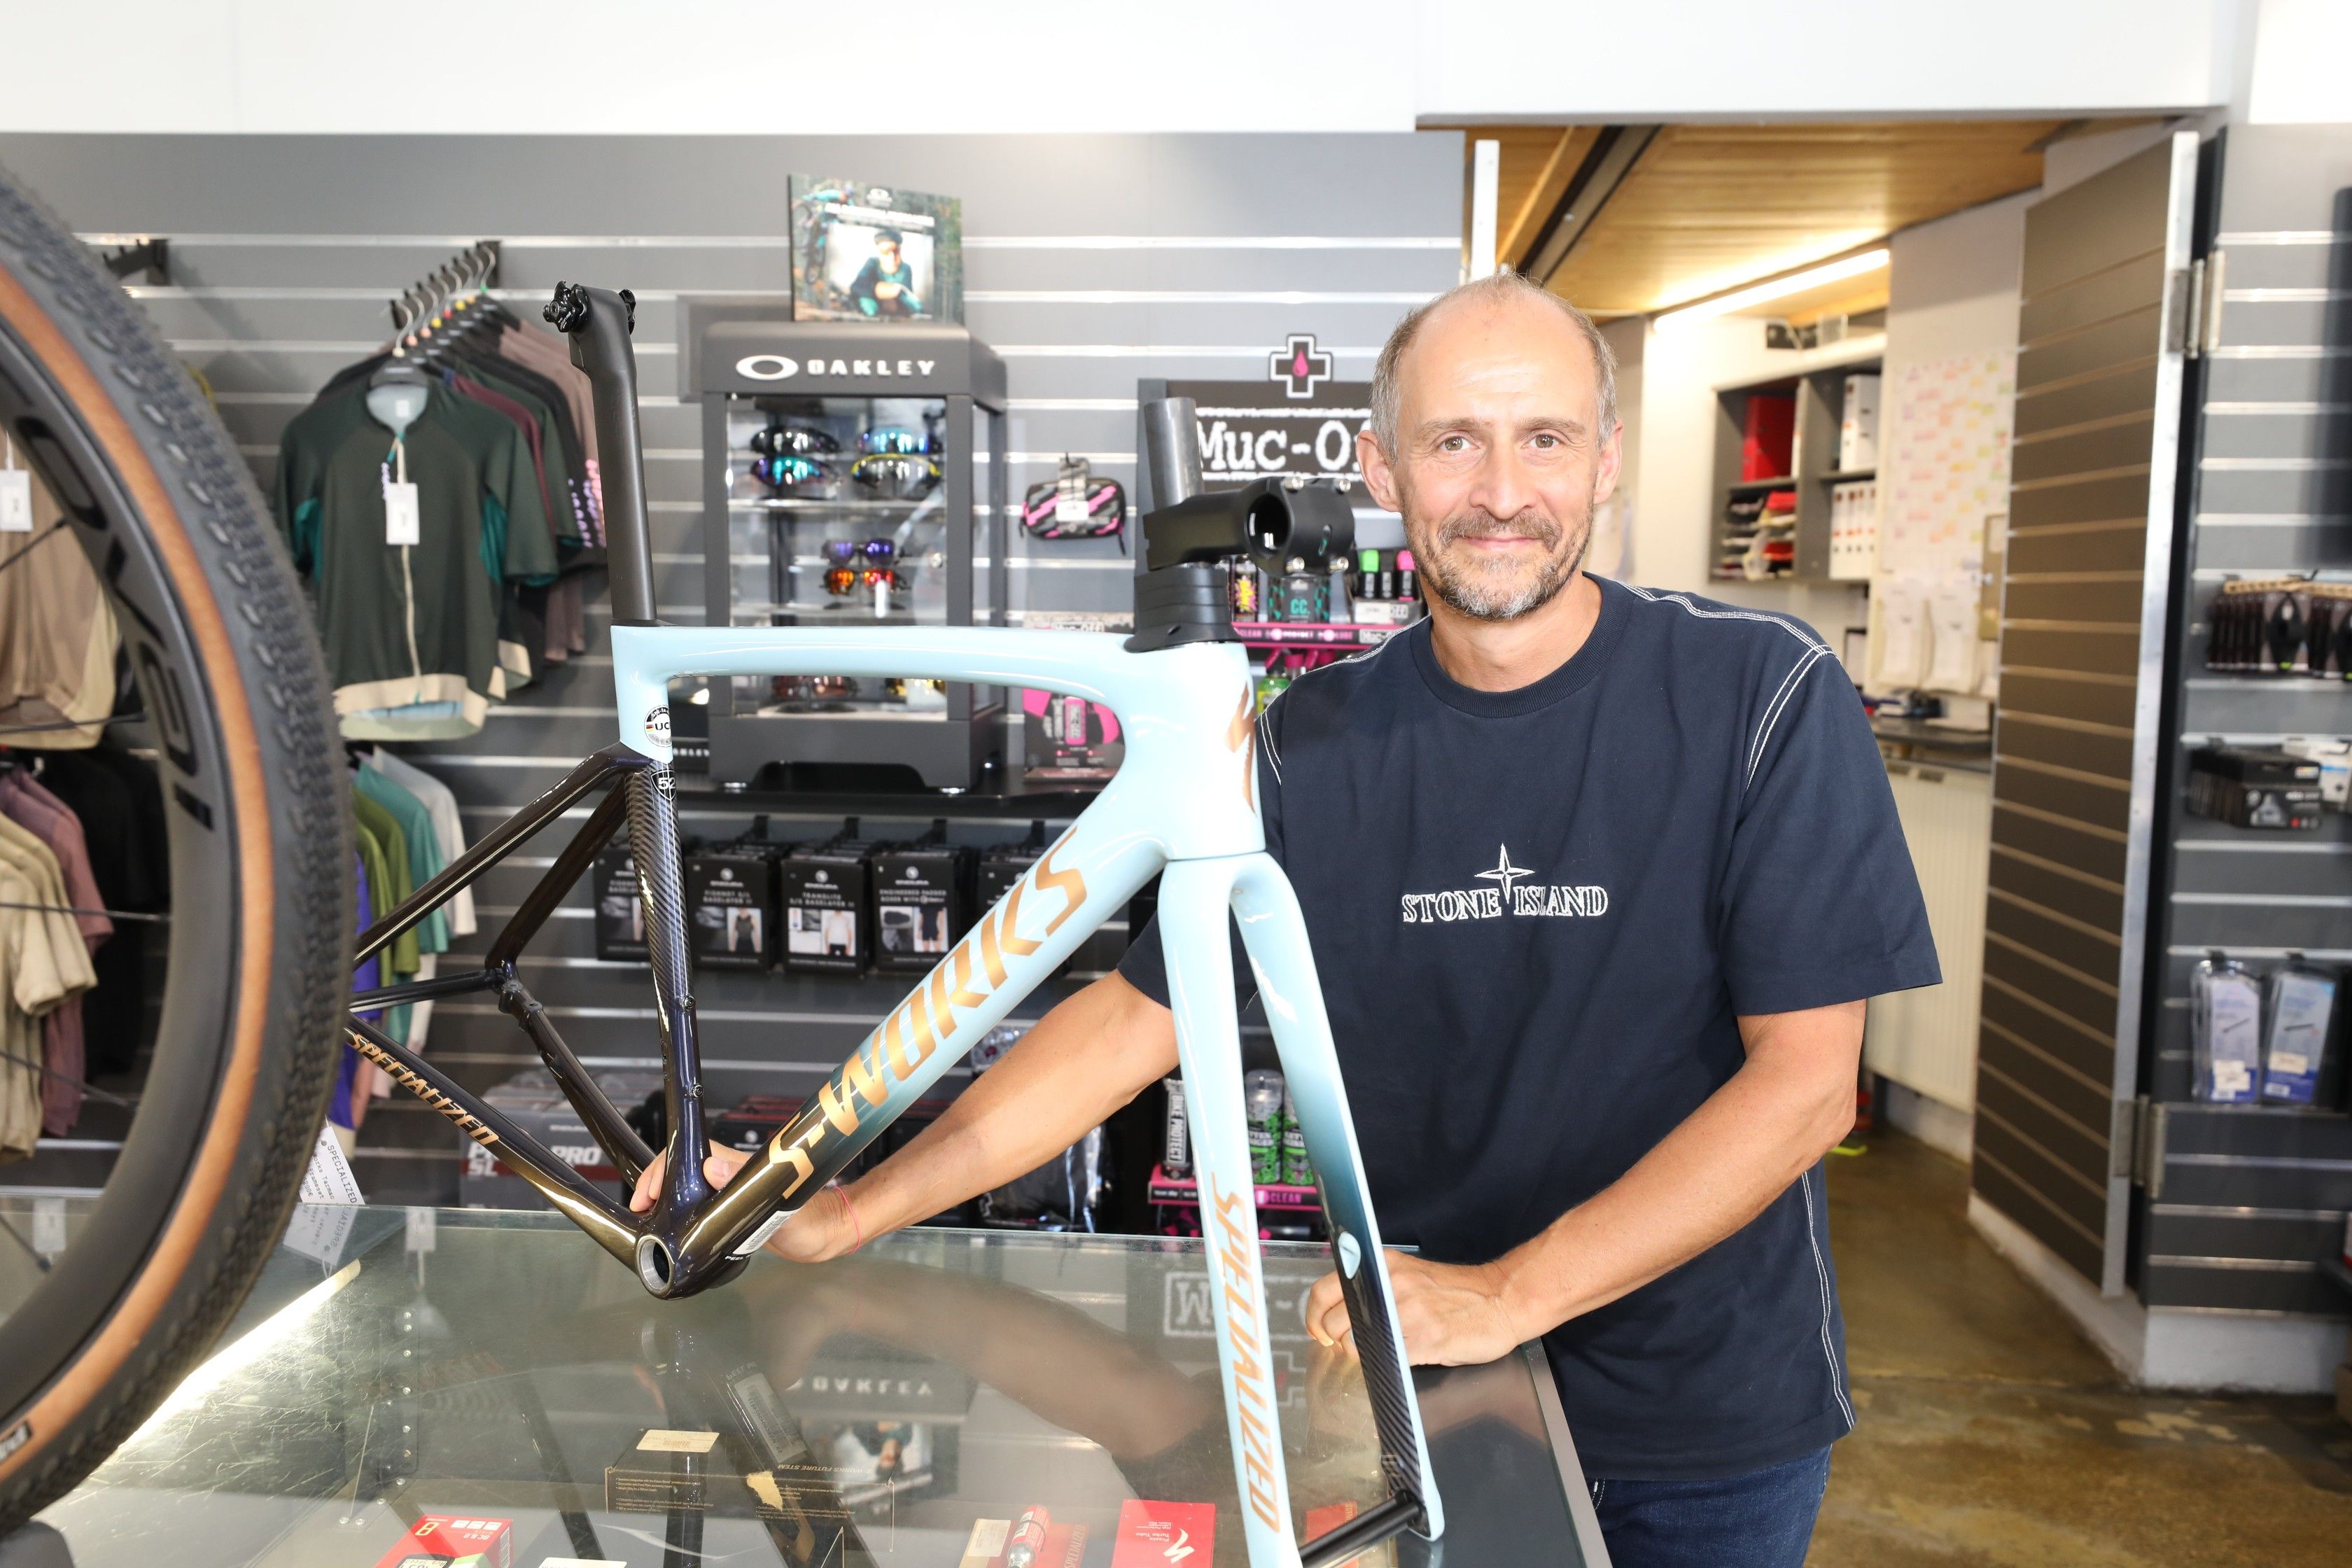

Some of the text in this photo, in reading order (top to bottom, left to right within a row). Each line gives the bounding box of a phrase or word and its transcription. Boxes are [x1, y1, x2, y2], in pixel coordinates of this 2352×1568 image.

[807, 359, 935, 377] OAKLEY
[1196, 419, 1371, 471] Muc-O
[654, 722, 671, 730] UC
[658, 778, 676, 790] 52
[1402, 886, 1608, 923] STONE ISLAND
[770, 826, 1087, 1199] S-WORKS
[345, 1033, 499, 1145] SPECIALIZED
[550, 1145, 602, 1166] PRO
[322, 1175, 335, 1200] Tarmac
[327, 1144, 358, 1204] SPECIALIZED
[1268, 1193, 1302, 1204] CLEAN
[1210, 1170, 1281, 1533] SPECIALIZED
